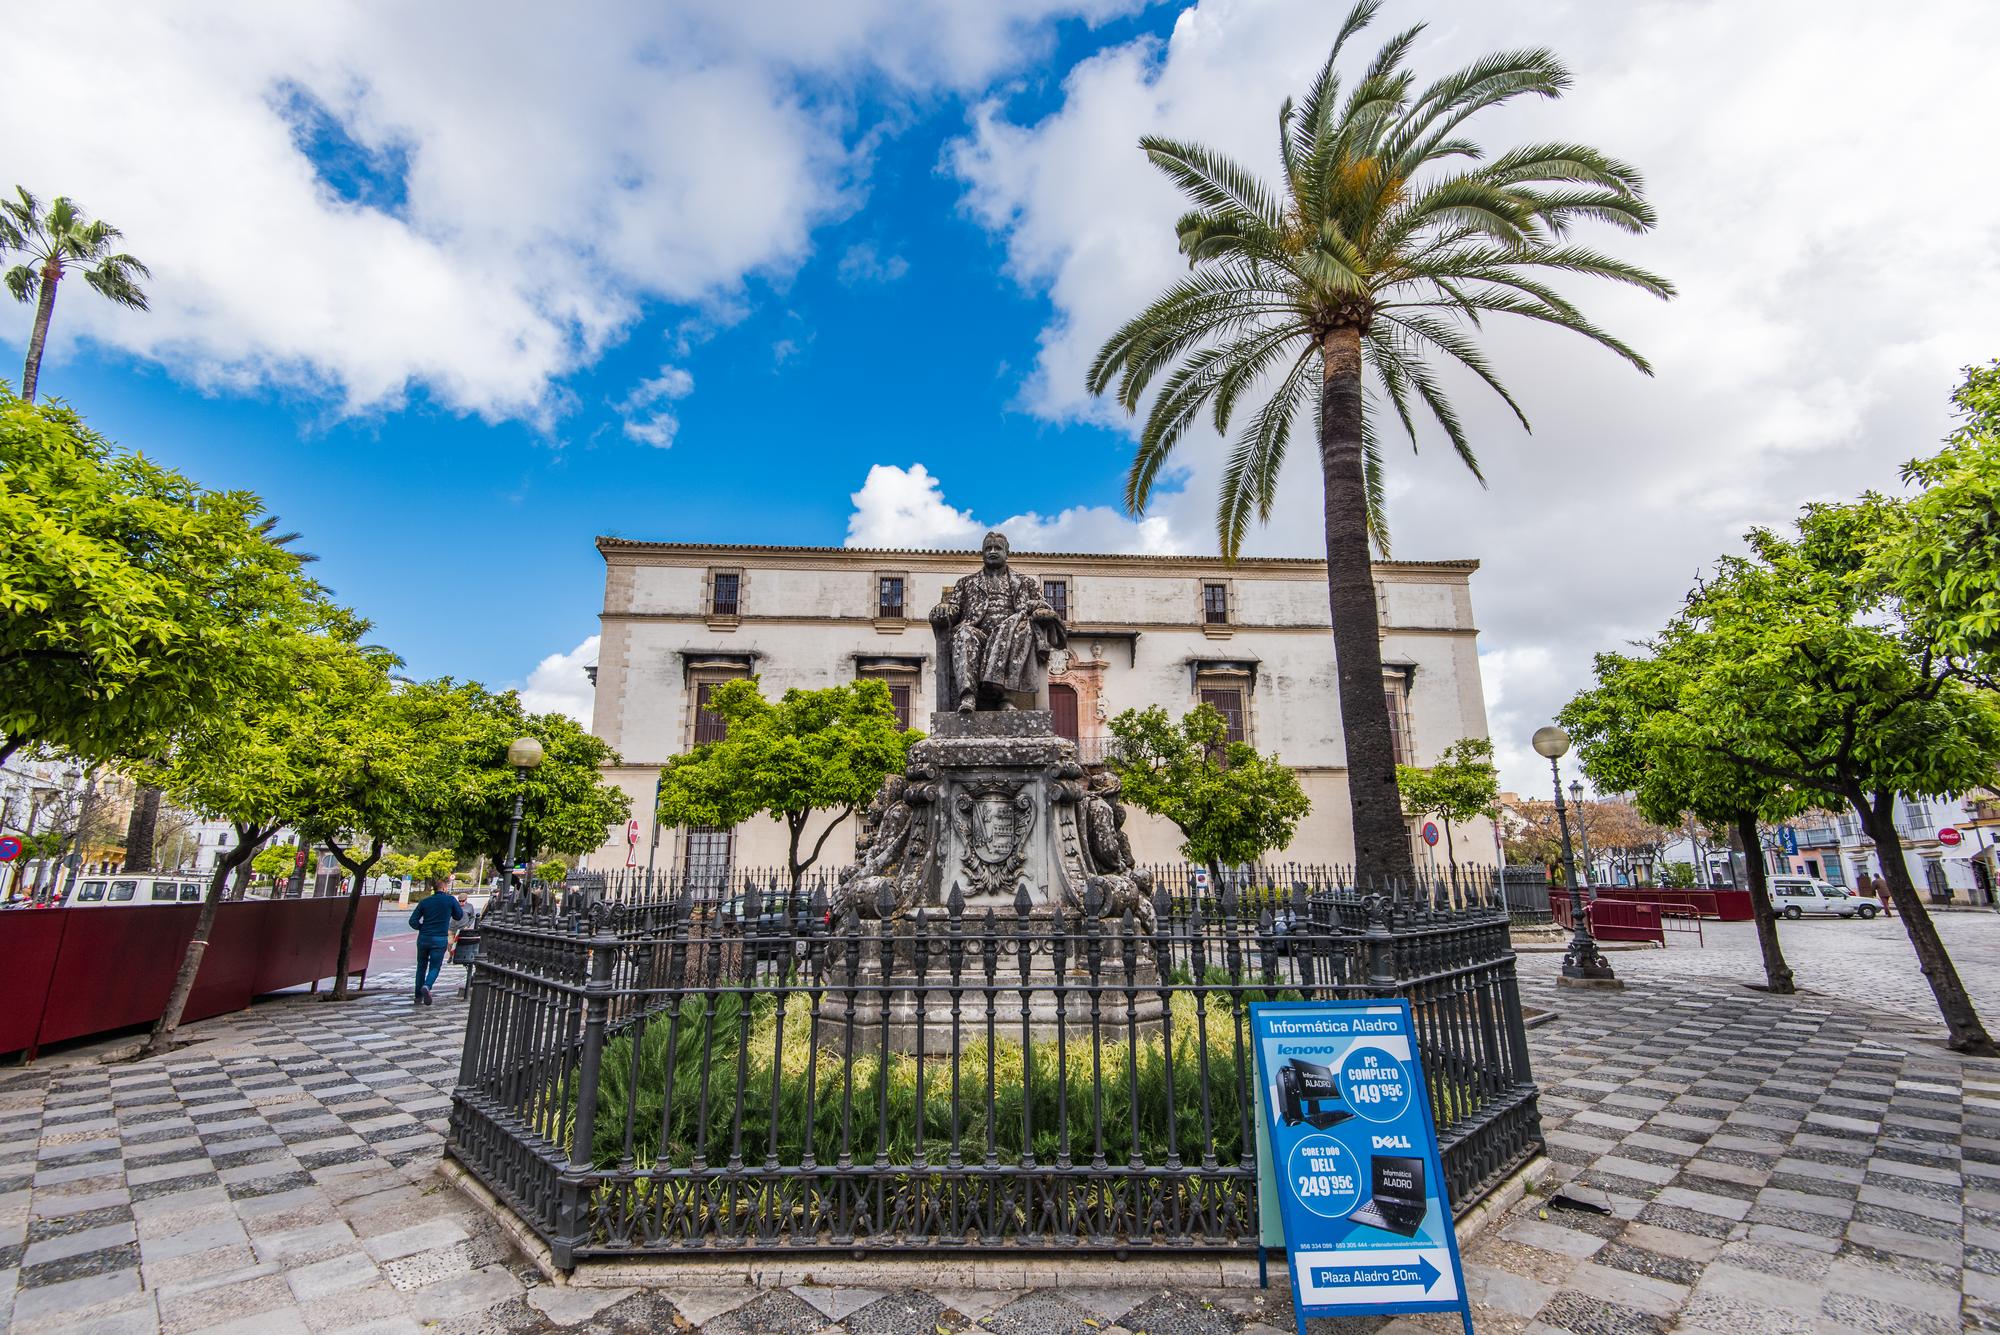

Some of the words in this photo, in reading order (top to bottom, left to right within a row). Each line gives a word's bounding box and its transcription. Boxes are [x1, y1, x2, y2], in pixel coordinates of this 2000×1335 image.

[1269, 1020, 1349, 1034] Informática
[1352, 1018, 1398, 1032] Aladro
[1277, 1043, 1335, 1055] lenovo
[1363, 1056, 1378, 1068] PC
[1347, 1068, 1399, 1081] COMPLETO
[1371, 1135, 1412, 1149] DELL
[1301, 1147, 1320, 1157] CORE
[1319, 1146, 1326, 1156] 2
[1310, 1158, 1337, 1173] DELL
[1383, 1177, 1413, 1189] ALADRO
[1321, 1271, 1351, 1284] Plaza
[1353, 1270, 1390, 1283] Aladro
[1391, 1269, 1422, 1281] 20m.
